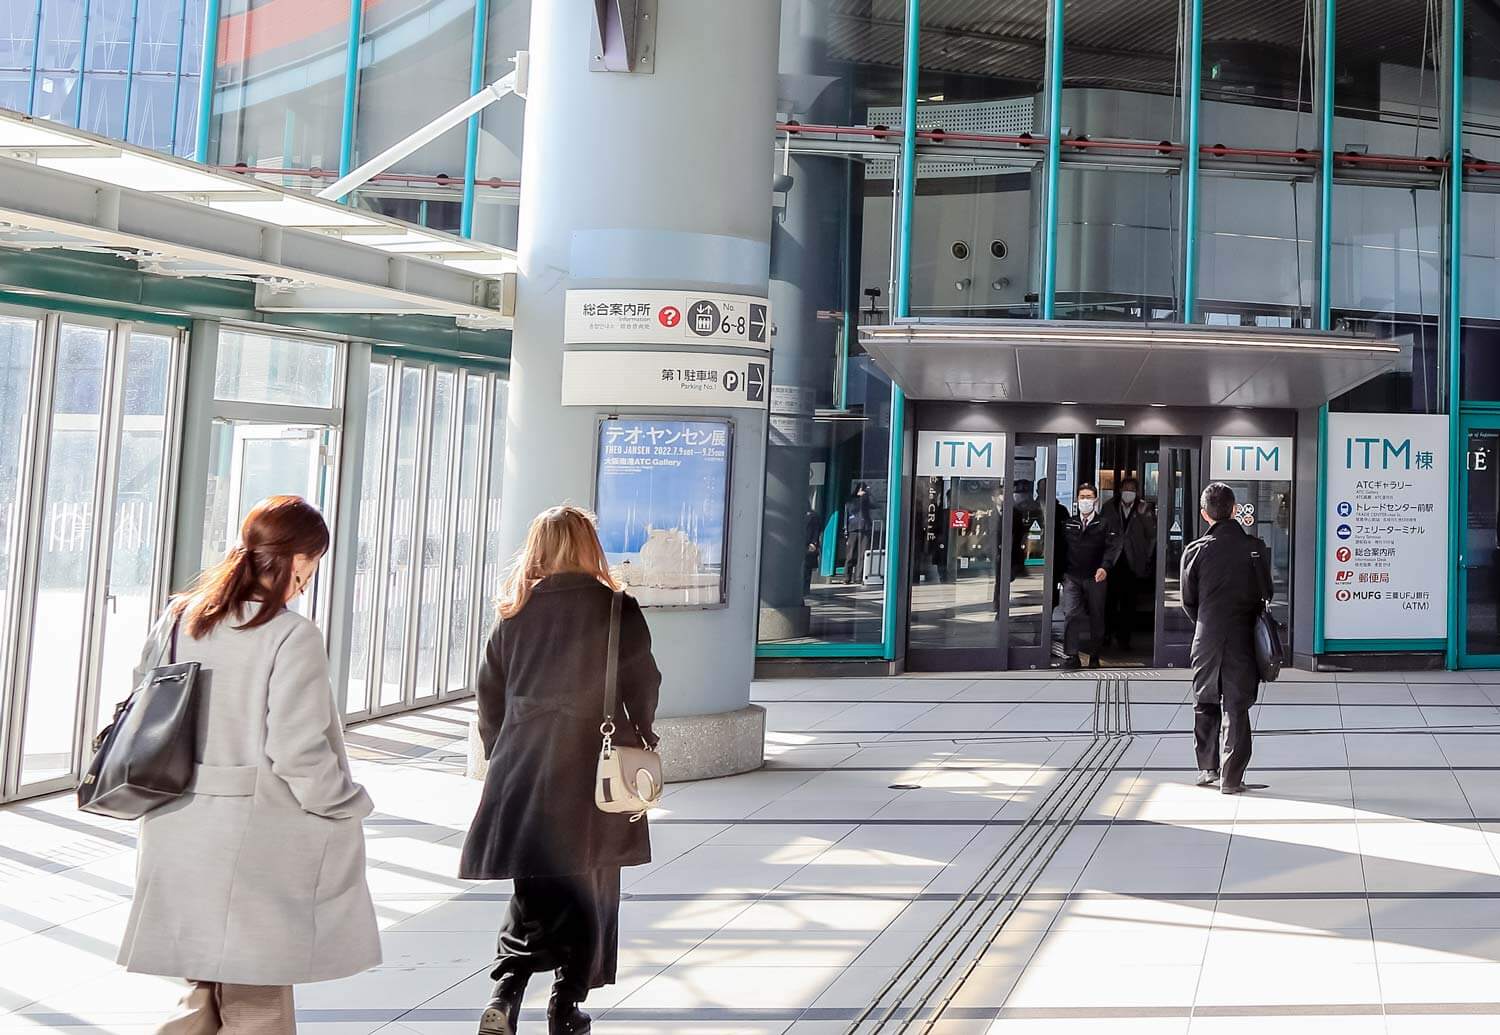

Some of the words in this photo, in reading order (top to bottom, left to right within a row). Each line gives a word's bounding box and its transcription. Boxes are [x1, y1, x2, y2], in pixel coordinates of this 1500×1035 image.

[583, 303, 651, 317] 総合案内所
[722, 303, 735, 312] No.
[661, 369, 718, 383] 第1駐車場
[680, 383, 702, 391] Parking
[604, 445, 622, 455] THEO
[934, 440, 992, 468] ITM
[1225, 446, 1279, 472] ITM
[1355, 480, 1413, 490] ATCギャラリー
[1356, 503, 1434, 513] トレードセンター前駅
[1355, 525, 1425, 535] フェリーターミナル
[1355, 547, 1396, 557] 総合案内所
[1358, 572, 1390, 583] 郵便局
[1353, 591, 1382, 600] MUFG
[1402, 601, 1430, 610] (ATM)
